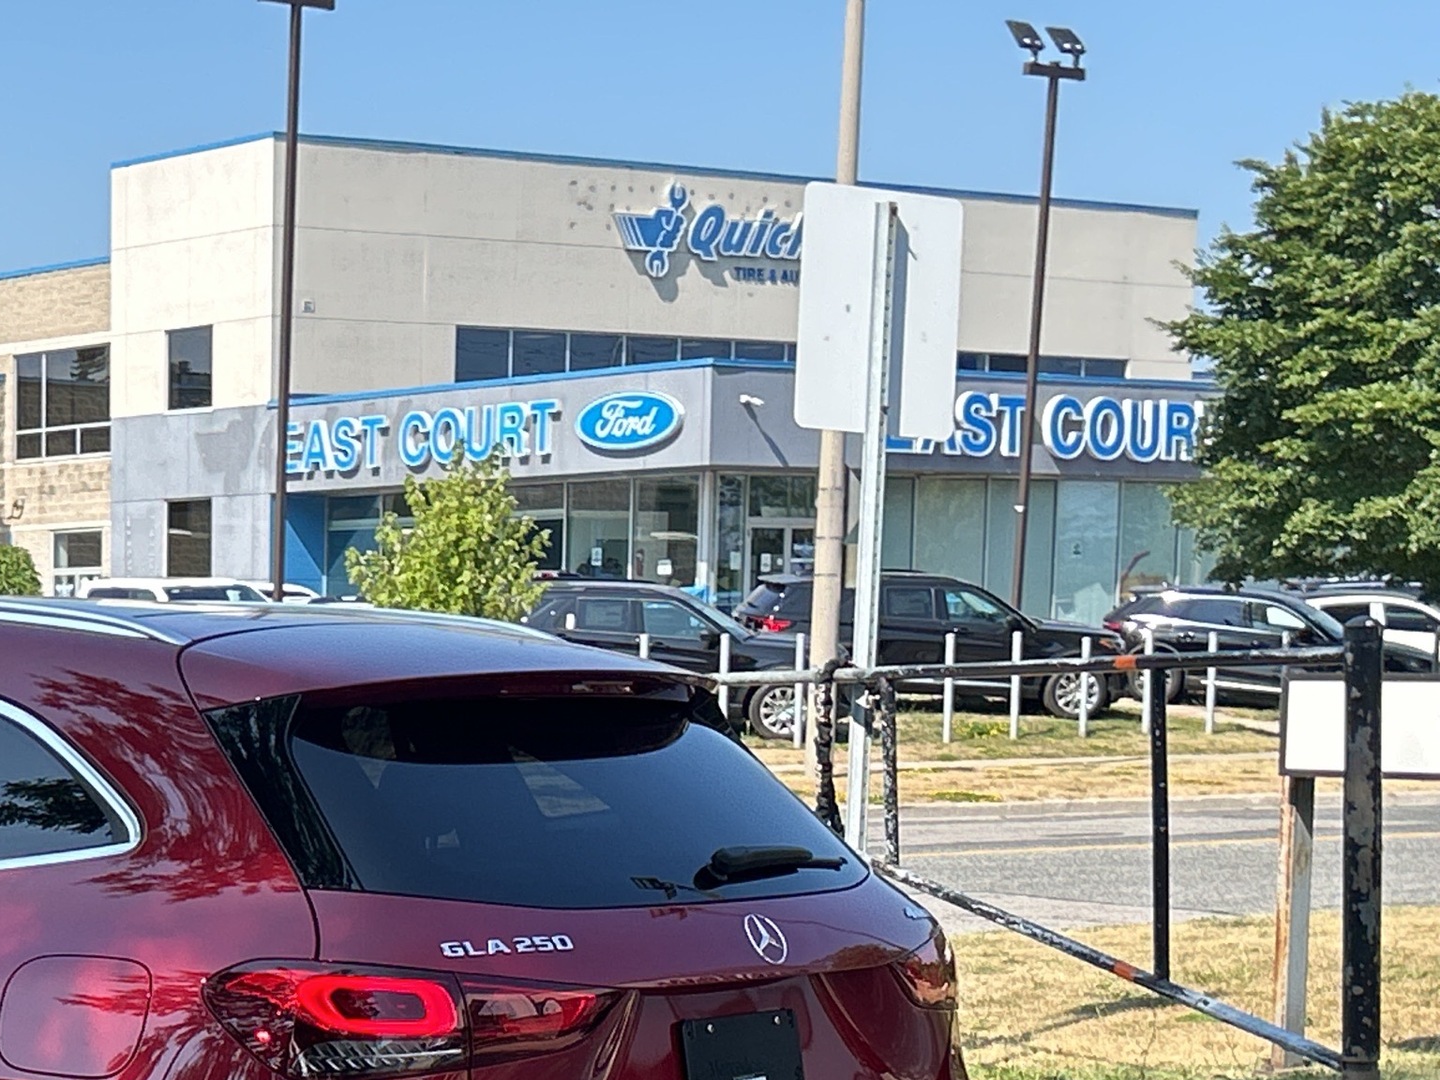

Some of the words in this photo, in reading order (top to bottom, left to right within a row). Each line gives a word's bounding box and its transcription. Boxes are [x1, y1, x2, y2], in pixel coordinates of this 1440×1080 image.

[734, 266, 765, 284] TIRE
[781, 269, 800, 284] AU
[286, 414, 387, 474] EAST
[398, 399, 561, 467] COURT
[594, 399, 657, 439] Ford
[886, 391, 1028, 457] ST
[1042, 394, 1204, 462] COUR
[440, 938, 512, 958] GLA
[512, 934, 574, 953] 250
